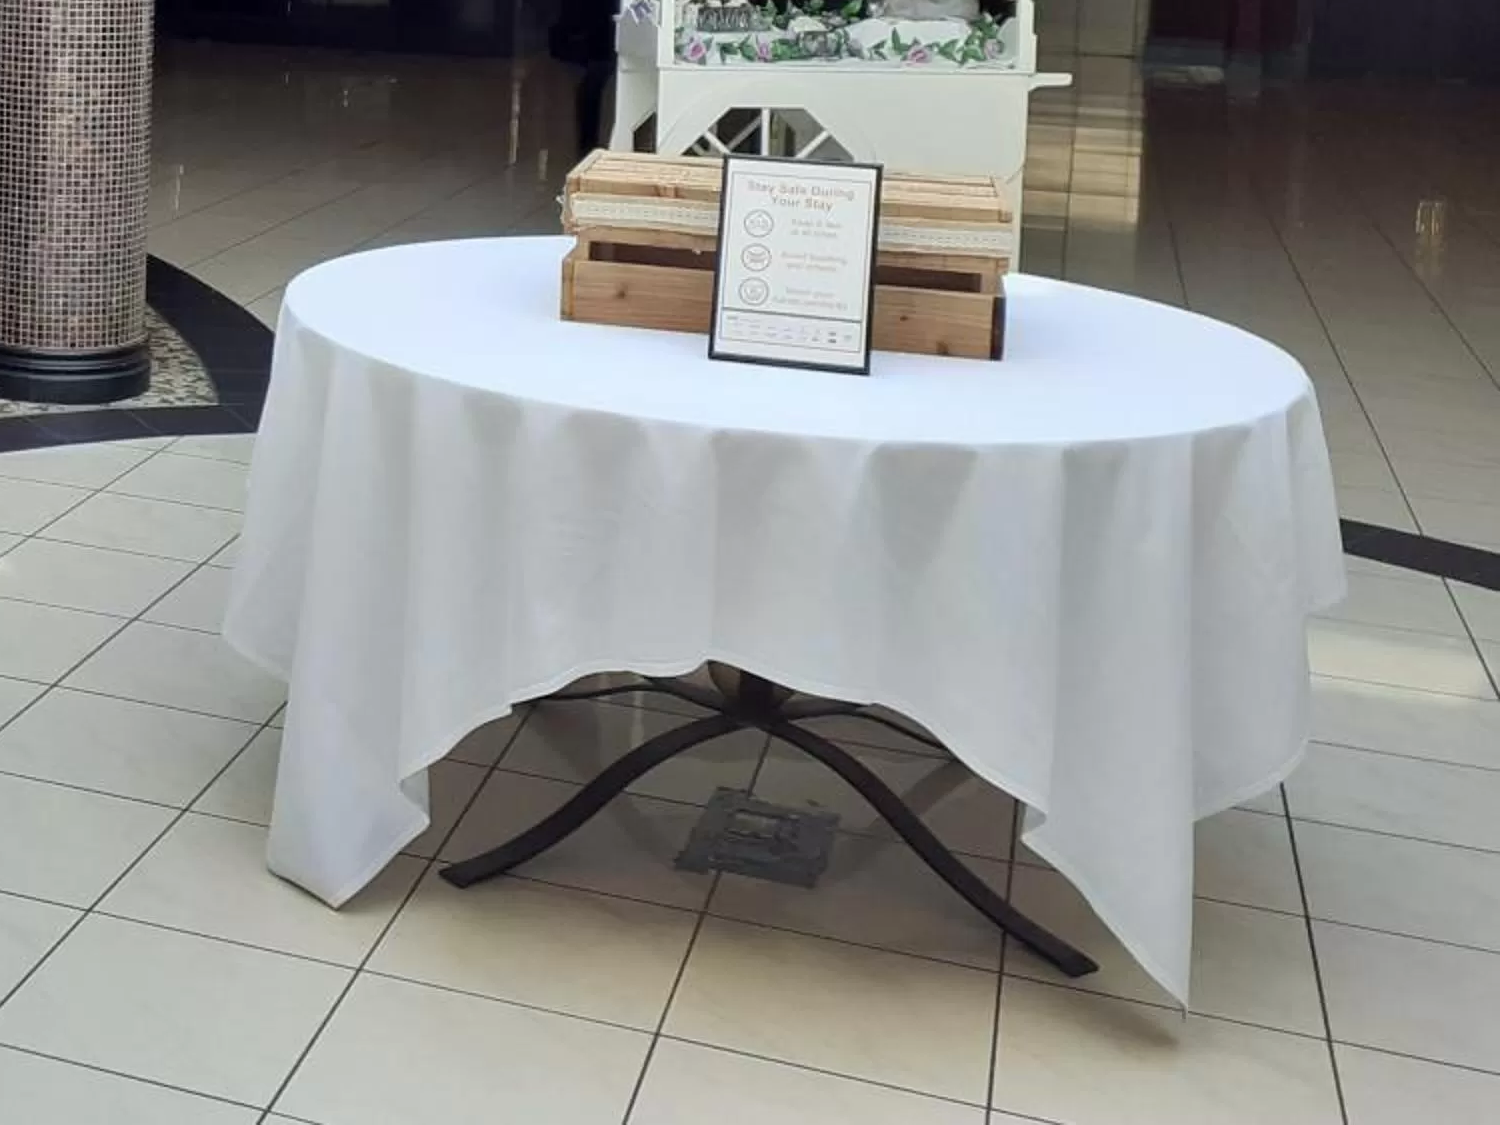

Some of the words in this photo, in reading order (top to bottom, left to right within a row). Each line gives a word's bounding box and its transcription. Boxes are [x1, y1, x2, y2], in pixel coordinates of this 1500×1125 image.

[748, 179, 775, 194] Stay
[778, 182, 807, 195] Safe
[811, 185, 855, 202] During
[771, 195, 801, 208] Your
[803, 197, 834, 212] Stay
